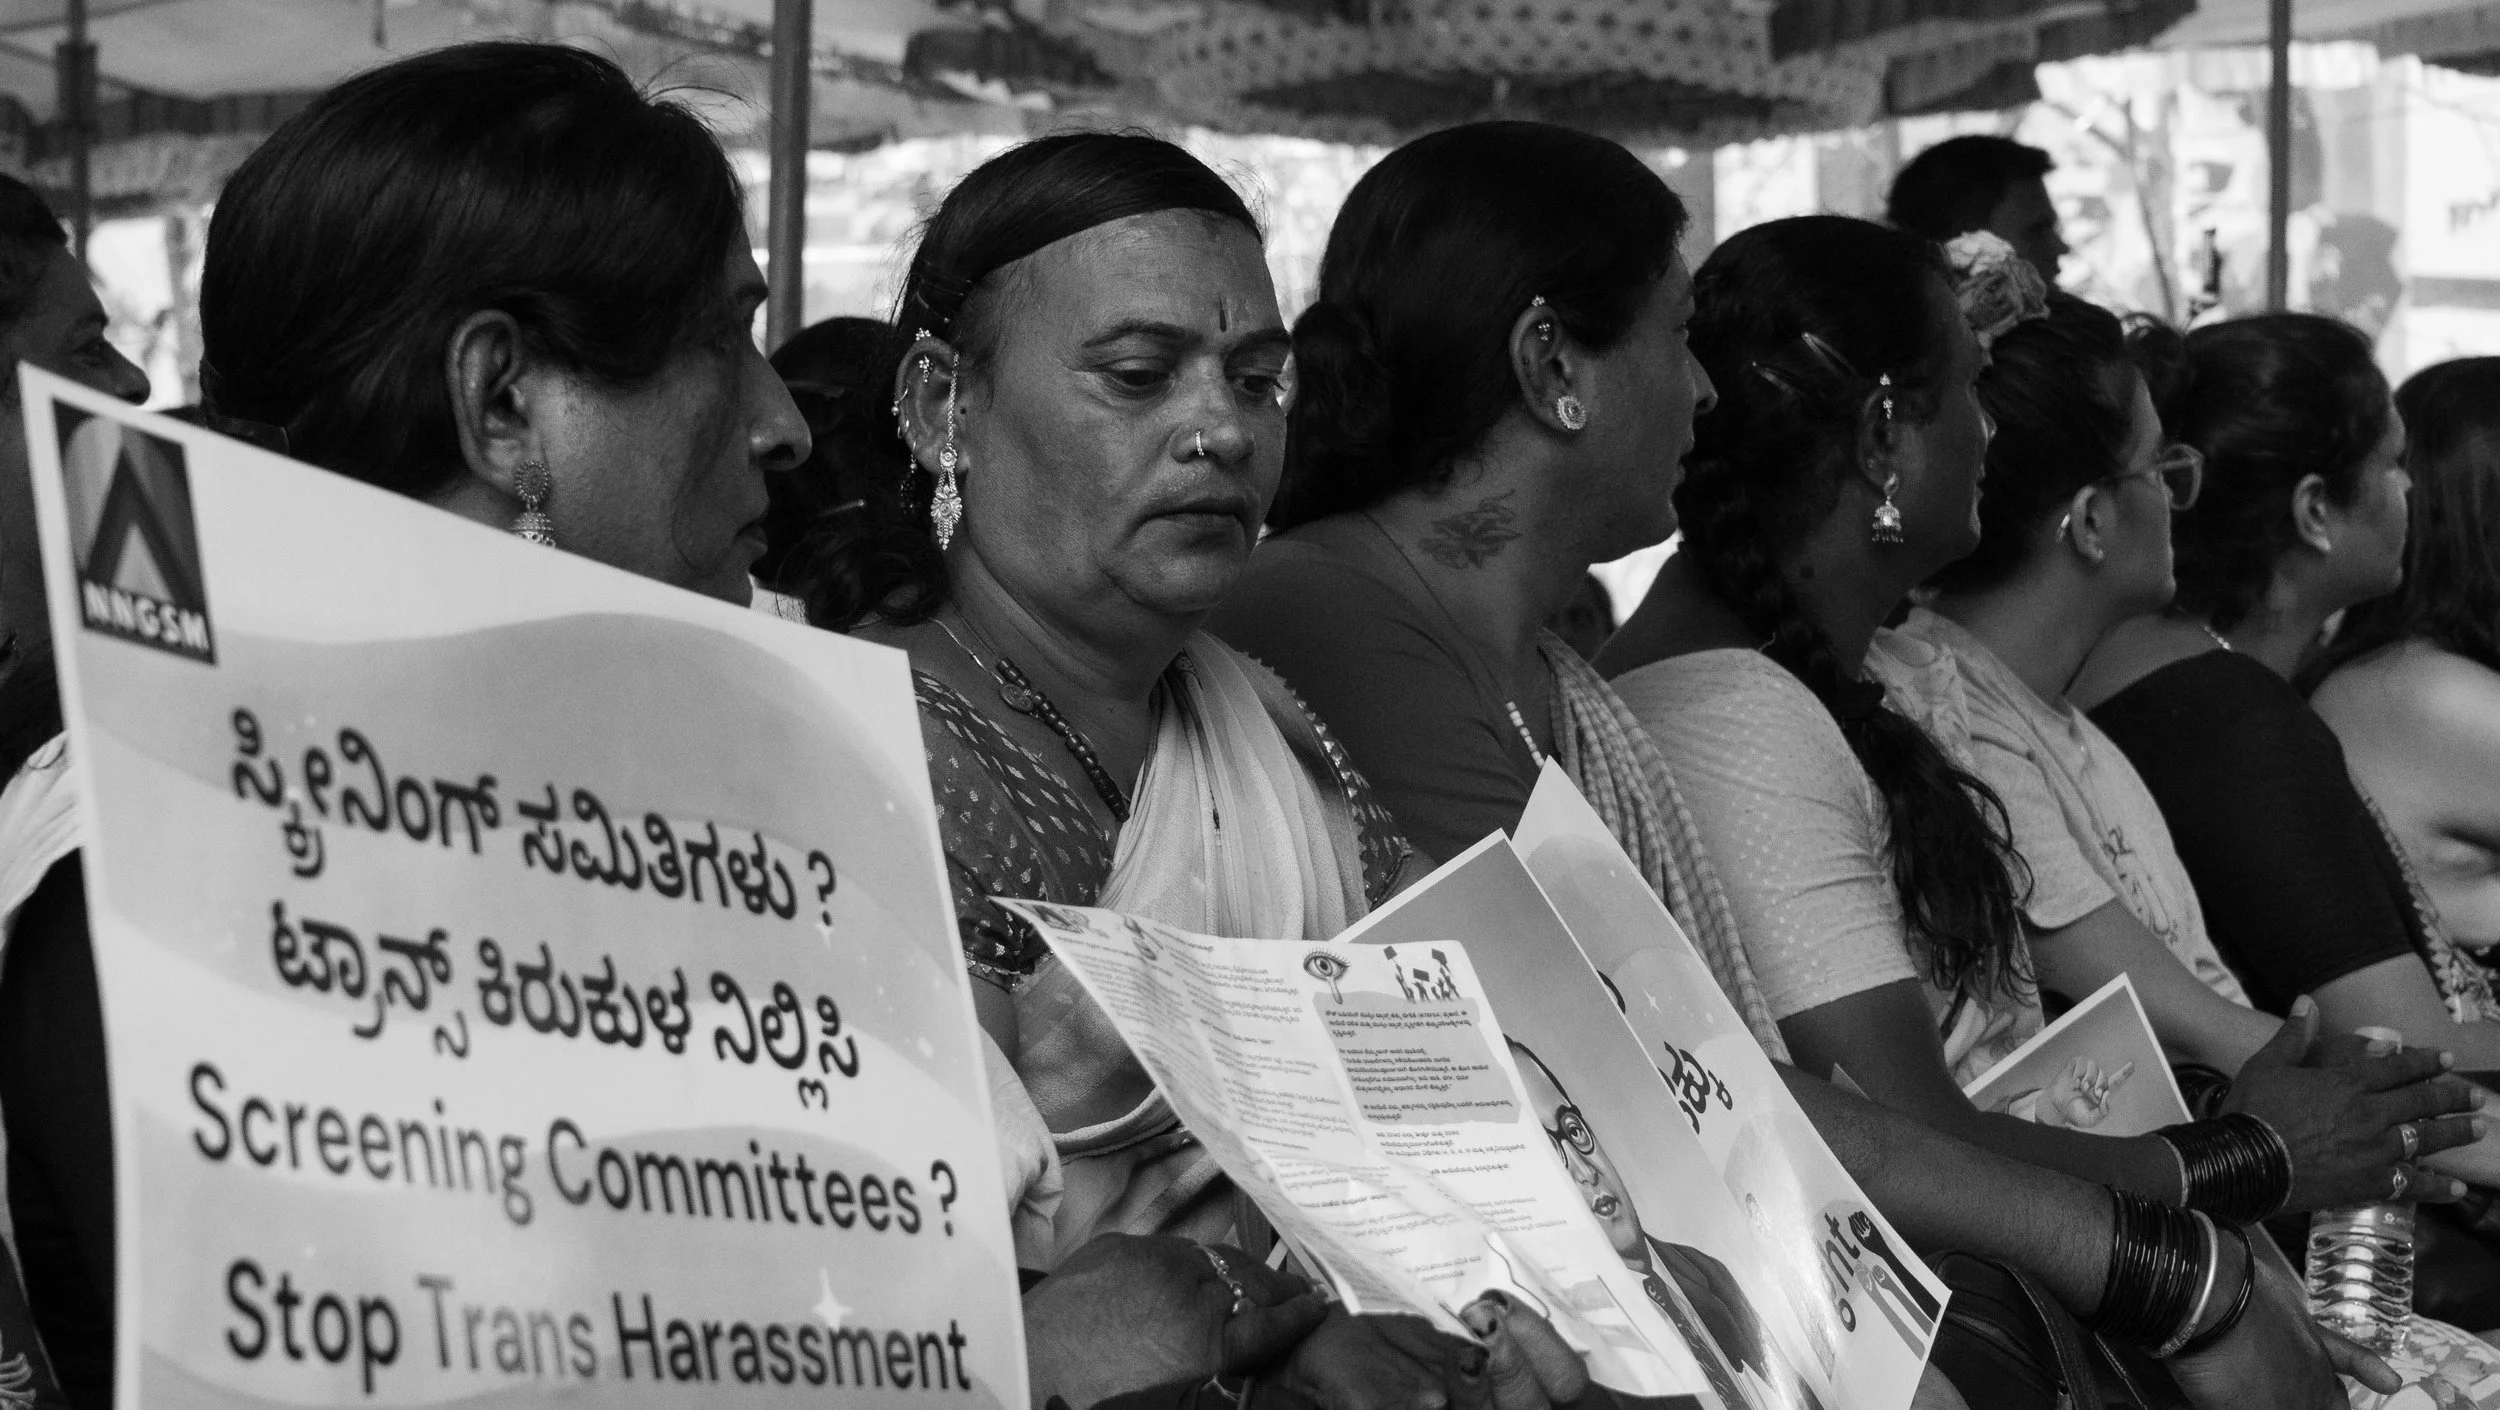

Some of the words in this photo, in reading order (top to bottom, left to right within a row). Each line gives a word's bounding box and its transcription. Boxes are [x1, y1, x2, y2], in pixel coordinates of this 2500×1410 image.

[82, 578, 210, 651] NNGSM
[231, 706, 501, 879] ಸ್ಕ್ರೀನಿಂಗ್
[271, 899, 470, 1060] ಟ್ರಾನ್ಸ್
[477, 936, 693, 1056] ಕಿರುಕುಳ
[709, 969, 860, 1112] ನಿಲ್ಲಿಸಿ
[189, 1062, 536, 1228] Screening
[224, 1257, 402, 1397] Stop
[416, 1272, 597, 1379] Trans
[611, 1290, 973, 1391] Harassment
